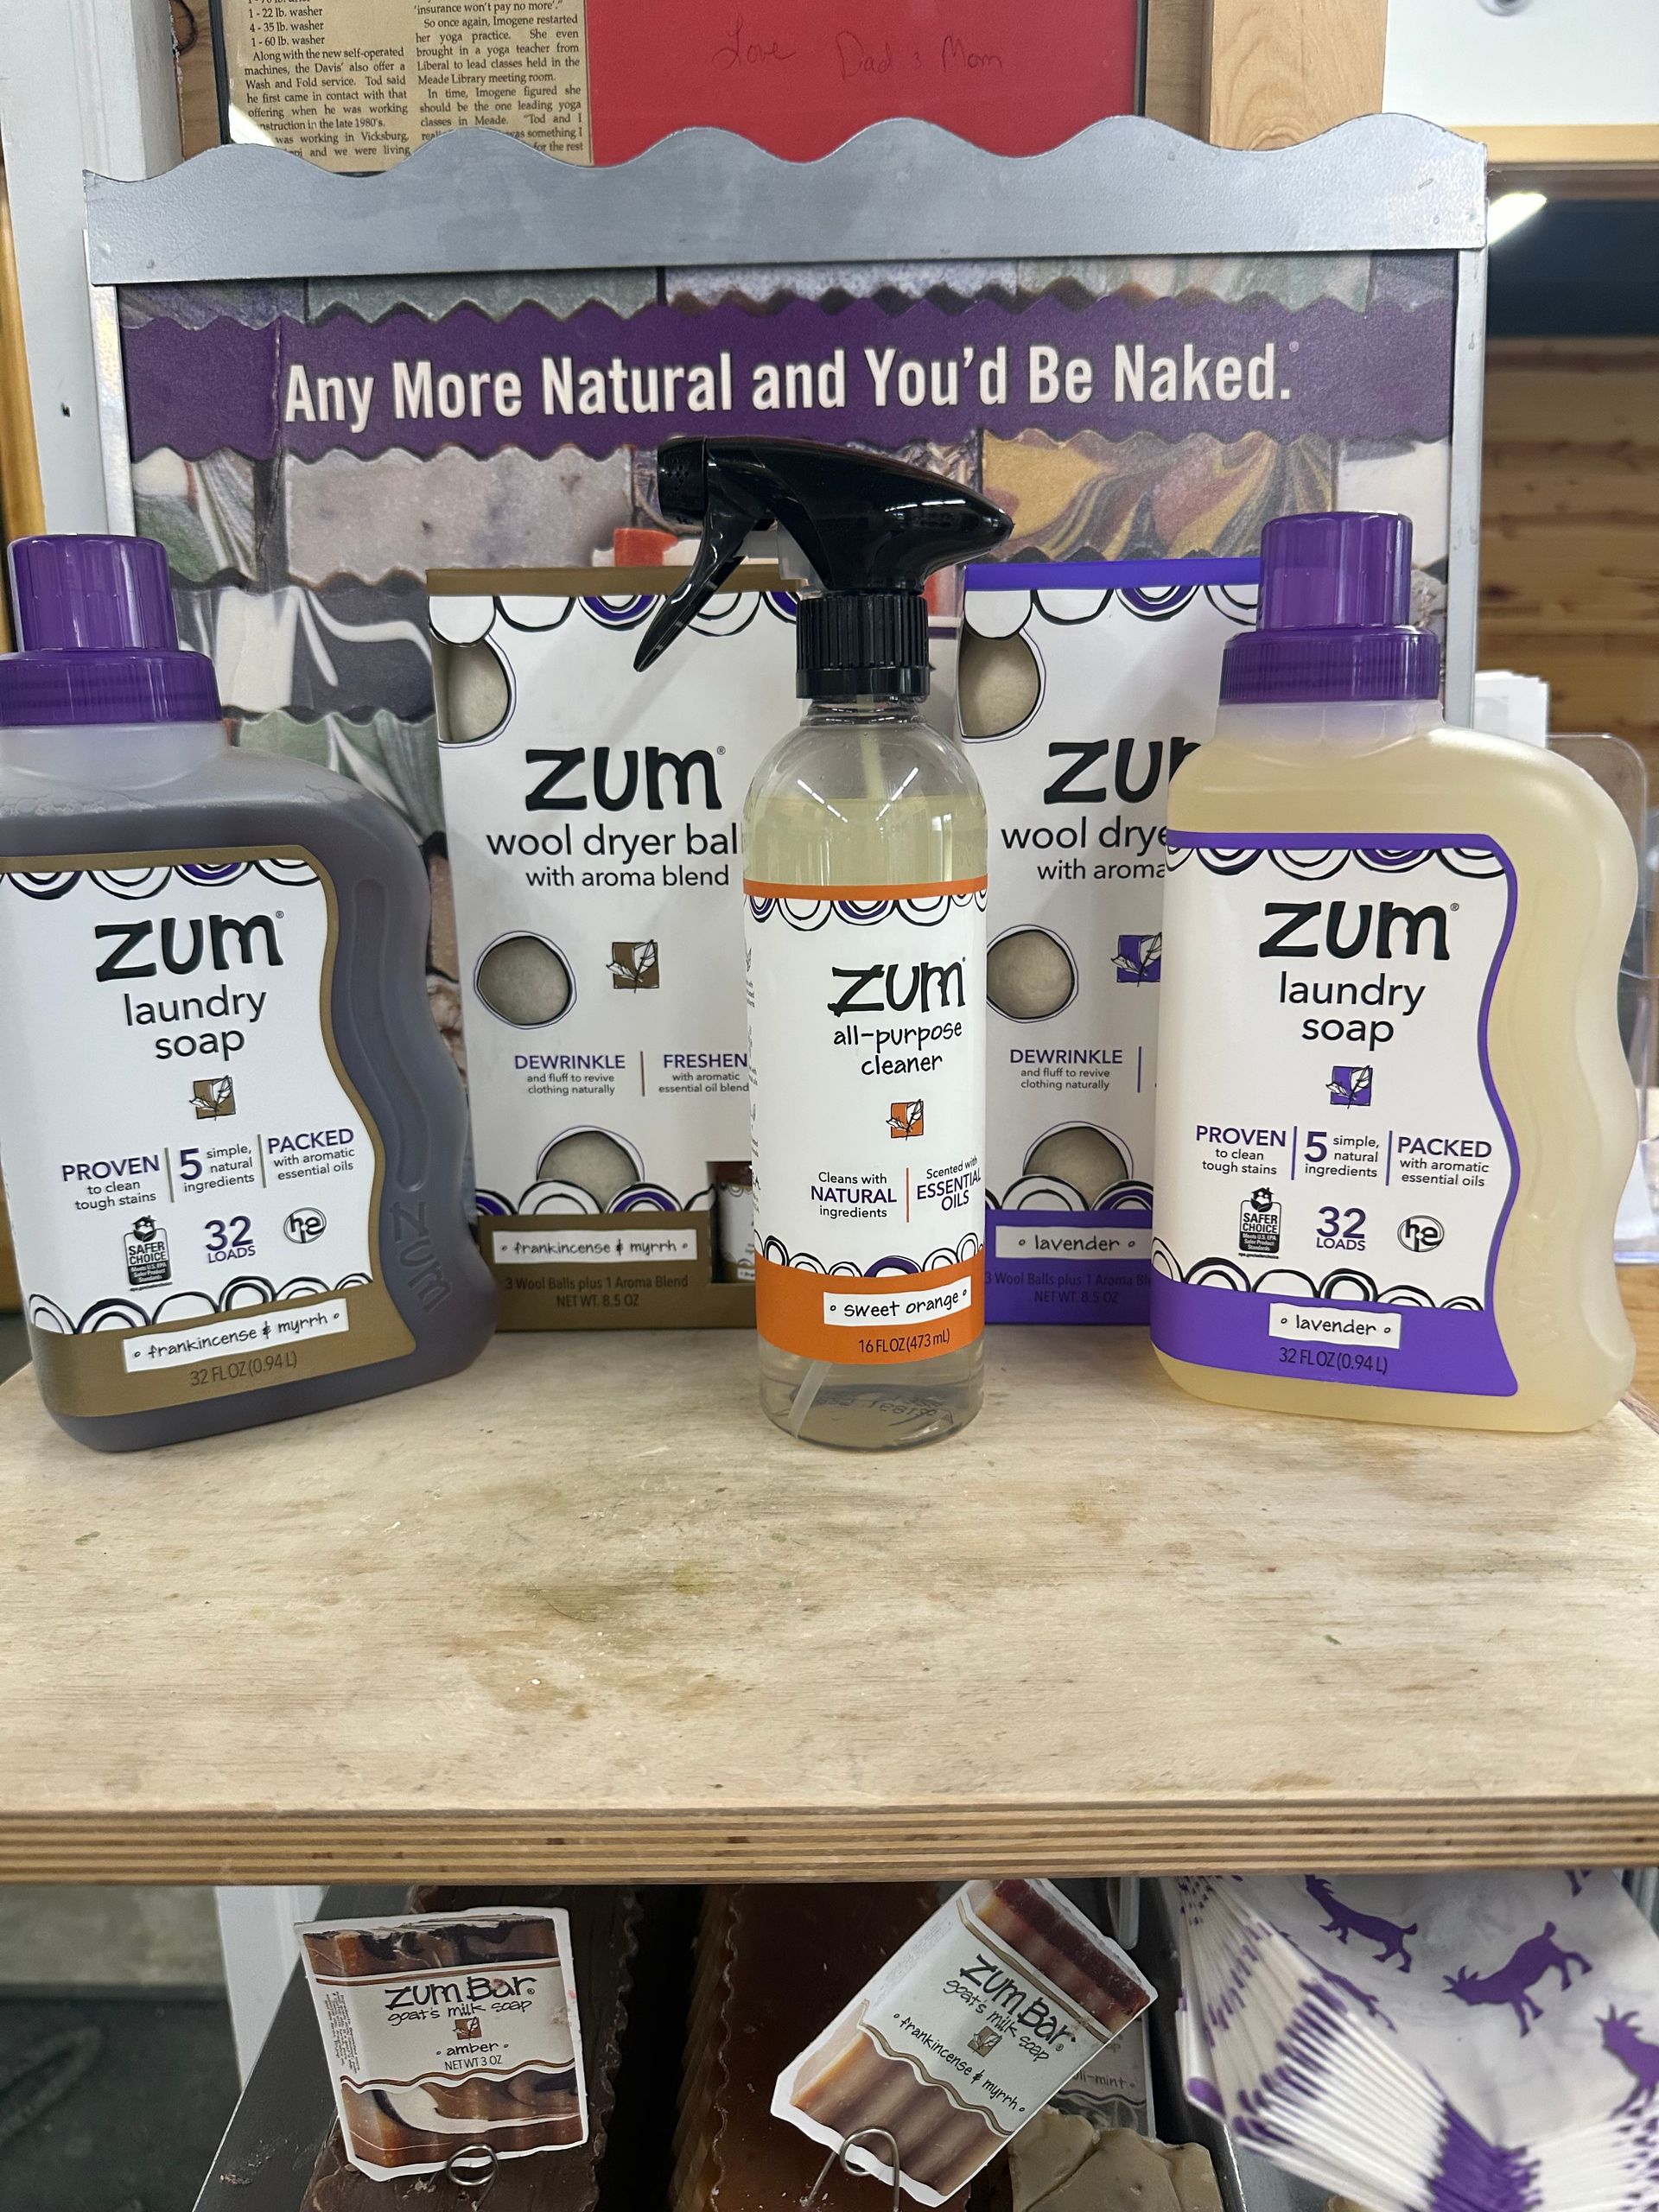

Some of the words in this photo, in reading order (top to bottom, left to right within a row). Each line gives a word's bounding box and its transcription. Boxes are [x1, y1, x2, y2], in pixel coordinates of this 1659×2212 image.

[424, 19, 435, 29] So
[462, 17, 491, 29] again,
[493, 16, 534, 27] Imogene
[537, 14, 578, 25] restarted
[416, 33, 431, 43] her
[440, 32, 462, 43] yoga
[472, 31, 512, 43] practice.
[530, 29, 547, 39] She
[556, 29, 579, 39] even
[253, 51, 281, 63] Along
[283, 49, 304, 60] with
[306, 48, 321, 59] the
[322, 49, 342, 58] new
[344, 47, 404, 60] self-operated
[711, 15, 797, 70] Love
[835, 30, 893, 81] Dad
[942, 35, 1003, 70] Mom
[285, 365, 374, 432] Any
[392, 360, 523, 419] More
[542, 352, 733, 416] Natural
[752, 347, 846, 410] and
[864, 345, 1007, 408] You'd
[1030, 346, 1093, 404] Be
[1115, 342, 1292, 404] Naked.
[1001, 816, 1086, 849] wool
[486, 823, 572, 855] wool
[583, 823, 676, 865] dryer
[526, 865, 574, 887] with
[582, 869, 656, 887] aroma
[663, 864, 729, 886] blend
[1037, 859, 1086, 880] with
[1280, 970, 1426, 1016] laundry
[124, 984, 267, 1027] laundry
[834, 1021, 963, 1054] all-purpose
[1301, 1016, 1395, 1052] soap
[156, 1029, 245, 1061] soap
[514, 1055, 626, 1070] DEWRINKLE
[664, 1053, 748, 1068] FRESHEN
[861, 1055, 943, 1075] cleaner
[1010, 1049, 1123, 1065] DEWRINKLE
[527, 1073, 546, 1083] and
[548, 1072, 570, 1083] fluff
[571, 1073, 582, 1083] to
[583, 1072, 615, 1083] revive
[672, 1071, 694, 1082] with
[696, 1071, 741, 1081] aromatic
[528, 1084, 569, 1096] clothing
[571, 1084, 615, 1096] naturally
[658, 1083, 702, 1093] essential
[704, 1083, 718, 1093] oil
[720, 1082, 749, 1092] blend
[268, 1128, 354, 1154] PACKED
[1196, 1125, 1287, 1147] PROVEN
[273, 1153, 301, 1167] with
[302, 1147, 355, 1164] aromatic
[1215, 1148, 1228, 1160] to
[1230, 1148, 1264, 1160] clean
[1304, 1131, 1327, 1163] 5
[1332, 1135, 1379, 1149] simple,
[1333, 1150, 1378, 1163] natural
[1397, 1136, 1492, 1159] PACKED
[61, 1154, 160, 1182] PROVEN
[179, 1148, 203, 1180] 5
[207, 1142, 252, 1160] simple,
[210, 1157, 254, 1173] natural
[277, 1162, 331, 1180] essential
[333, 1160, 354, 1173] oils
[926, 1160, 963, 1179] Scented
[963, 1154, 978, 1167] with
[1202, 1160, 1239, 1174] tough
[1241, 1161, 1277, 1175] stains
[1304, 1163, 1377, 1179] ingredients
[1400, 1158, 1427, 1170] with
[1430, 1159, 1489, 1173] aromatic
[87, 1184, 103, 1196] to
[105, 1178, 141, 1194] clean
[183, 1172, 256, 1194] ingredients
[818, 1172, 858, 1185] Cleans
[861, 1173, 887, 1185] with
[917, 1167, 982, 1200] ESSENTIAL
[1401, 1173, 1459, 1186] essential
[1462, 1174, 1484, 1187] oils
[74, 1196, 117, 1211] tough
[119, 1191, 157, 1208] stains
[810, 1185, 897, 1204] NATURAL
[941, 1189, 969, 1211] OILS
[819, 1205, 887, 1219] ingredients
[1243, 1212, 1278, 1224] SAFER
[1316, 1205, 1366, 1239] 32
[205, 1216, 254, 1253] 32
[1243, 1223, 1278, 1234] CHOICE
[129, 1242, 166, 1255] SAFER
[514, 1242, 611, 1255] frankincense
[630, 1240, 677, 1255] myrrh
[1034, 1235, 1120, 1251] lavender
[1316, 1237, 1366, 1251] LOADS
[130, 1251, 167, 1265] CHOICE
[208, 1245, 256, 1263] LOADS
[843, 1302, 900, 1319] sweet
[906, 1293, 959, 1314] orange
[1296, 1314, 1376, 1336] lavender
[149, 1328, 257, 1359] frankincense
[262, 1321, 272, 1338] &
[277, 1312, 328, 1334] myrrh
[859, 1339, 874, 1353] 16
[876, 1339, 888, 1352] FL
[890, 1338, 905, 1352] OZ
[906, 1333, 931, 1352] (473
[933, 1328, 950, 1344] mL)
[190, 1369, 208, 1386] 32
[212, 1365, 226, 1382] FL
[228, 1361, 246, 1378] OZ
[249, 1353, 283, 1376] (0.94
[286, 1351, 297, 1369] L)
[1279, 1347, 1296, 1363] 32
[1300, 1350, 1314, 1365] FL
[1316, 1351, 1335, 1367] OZ
[1337, 1352, 1373, 1370] (0.94
[1376, 1356, 1388, 1375] L)
[467, 1976, 537, 2001] Bar
[388, 2007, 441, 2026] goat's
[448, 2003, 486, 2018] milk
[492, 2000, 533, 2013] soap
[943, 1980, 988, 2014] goat's
[986, 2011, 1018, 2037] milk
[1019, 2036, 1050, 2063] soap
[1017, 1997, 1077, 2045] Bar
[447, 2042, 499, 2056] amber
[445, 2060, 462, 2071] NET
[462, 2057, 480, 2069] WT
[481, 2056, 487, 2065] 3
[489, 2055, 503, 2065] OZ
[899, 2017, 973, 2075] frankincense
[982, 2078, 1018, 2110] myrrh
